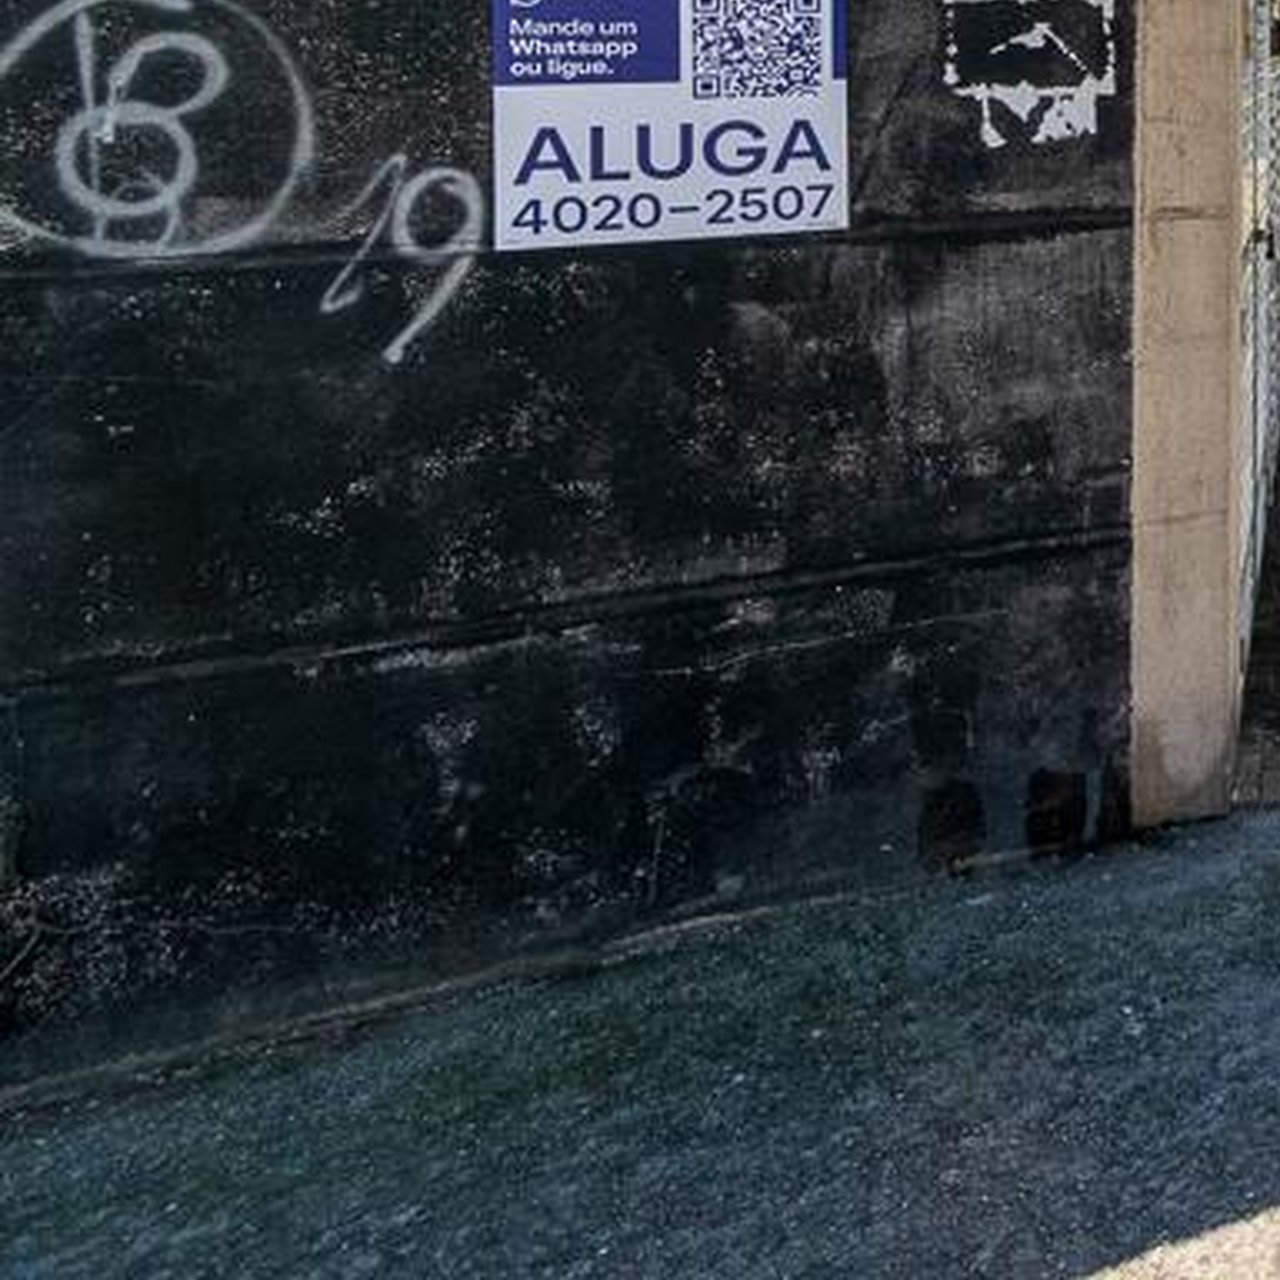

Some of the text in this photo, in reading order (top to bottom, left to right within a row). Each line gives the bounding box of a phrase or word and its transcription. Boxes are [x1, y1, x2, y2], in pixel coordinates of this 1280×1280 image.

[599, 22, 638, 35] um
[509, 38, 638, 59] Whatsapp
[510, 61, 542, 77] ou
[513, 120, 833, 186] ALUGA
[511, 184, 835, 235] 4020-2507
